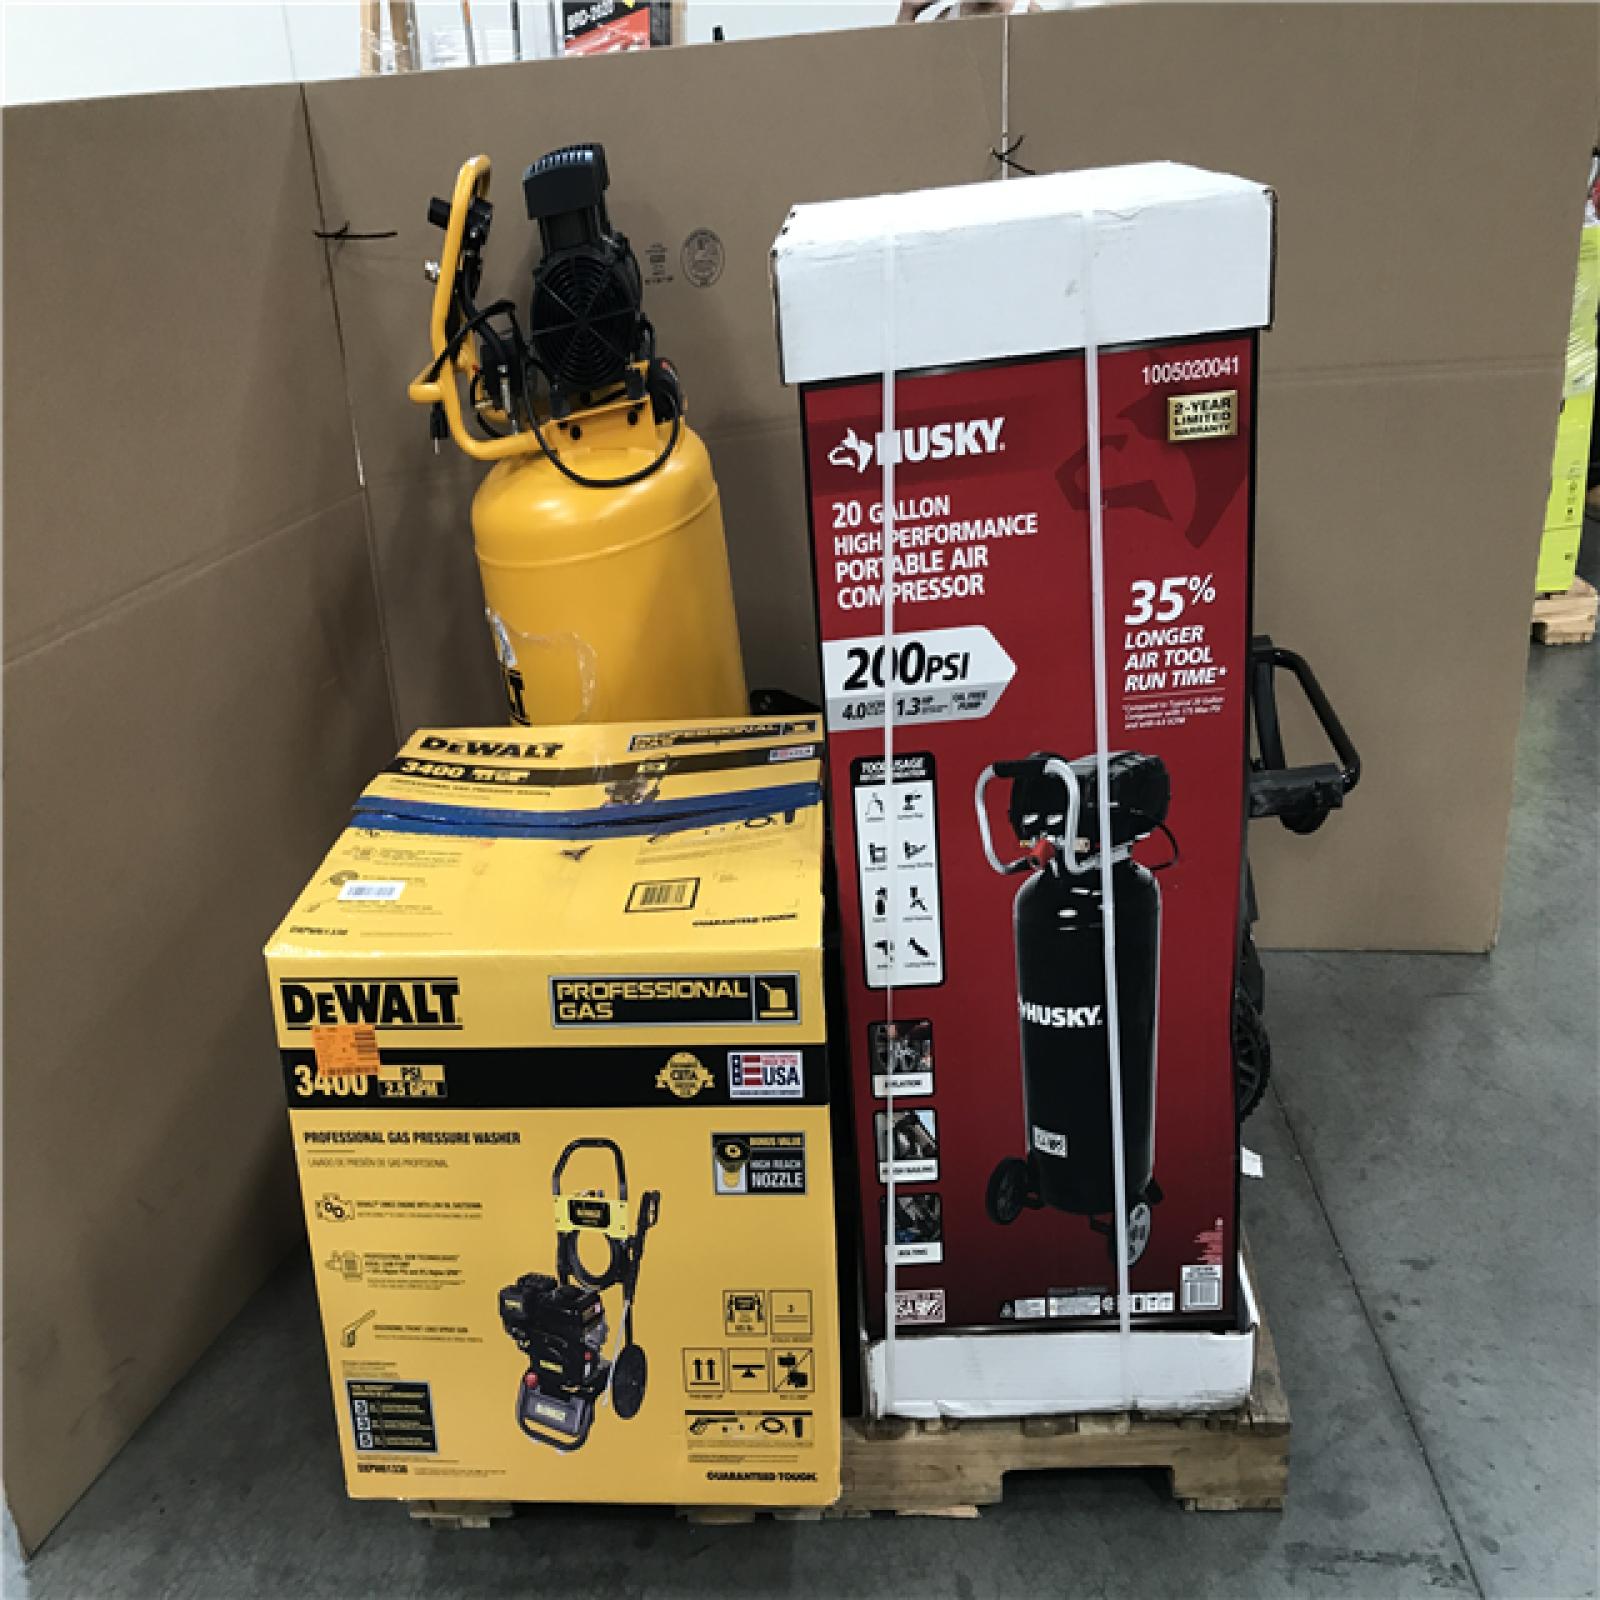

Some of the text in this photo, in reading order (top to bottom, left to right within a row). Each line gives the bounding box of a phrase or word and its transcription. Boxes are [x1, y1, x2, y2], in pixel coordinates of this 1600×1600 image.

[1174, 397, 1231, 416] 2-YEAR
[1174, 411, 1231, 426] LIMITED
[832, 495, 950, 528] 20 GLLON
[836, 545, 989, 583] PORABLE AIR
[1124, 572, 1216, 625] 35%
[1124, 625, 1205, 650] LONGER
[1124, 645, 1213, 671] AIR TOOL
[1124, 672, 1167, 692] RUN
[896, 697, 920, 716] 1.3
[400, 761, 466, 778] 3400
[556, 979, 748, 1000] PROFESSIONAL
[559, 1002, 614, 1020] GAS
[764, 1065, 801, 1086] USA
[303, 1131, 521, 1145] PROFESSIONAL GAS PRESSURE WASHER
[751, 1159, 801, 1170] HIGH REACH
[752, 1172, 804, 1188] NOZZLE
[706, 1471, 775, 1481] GUARANTEED
